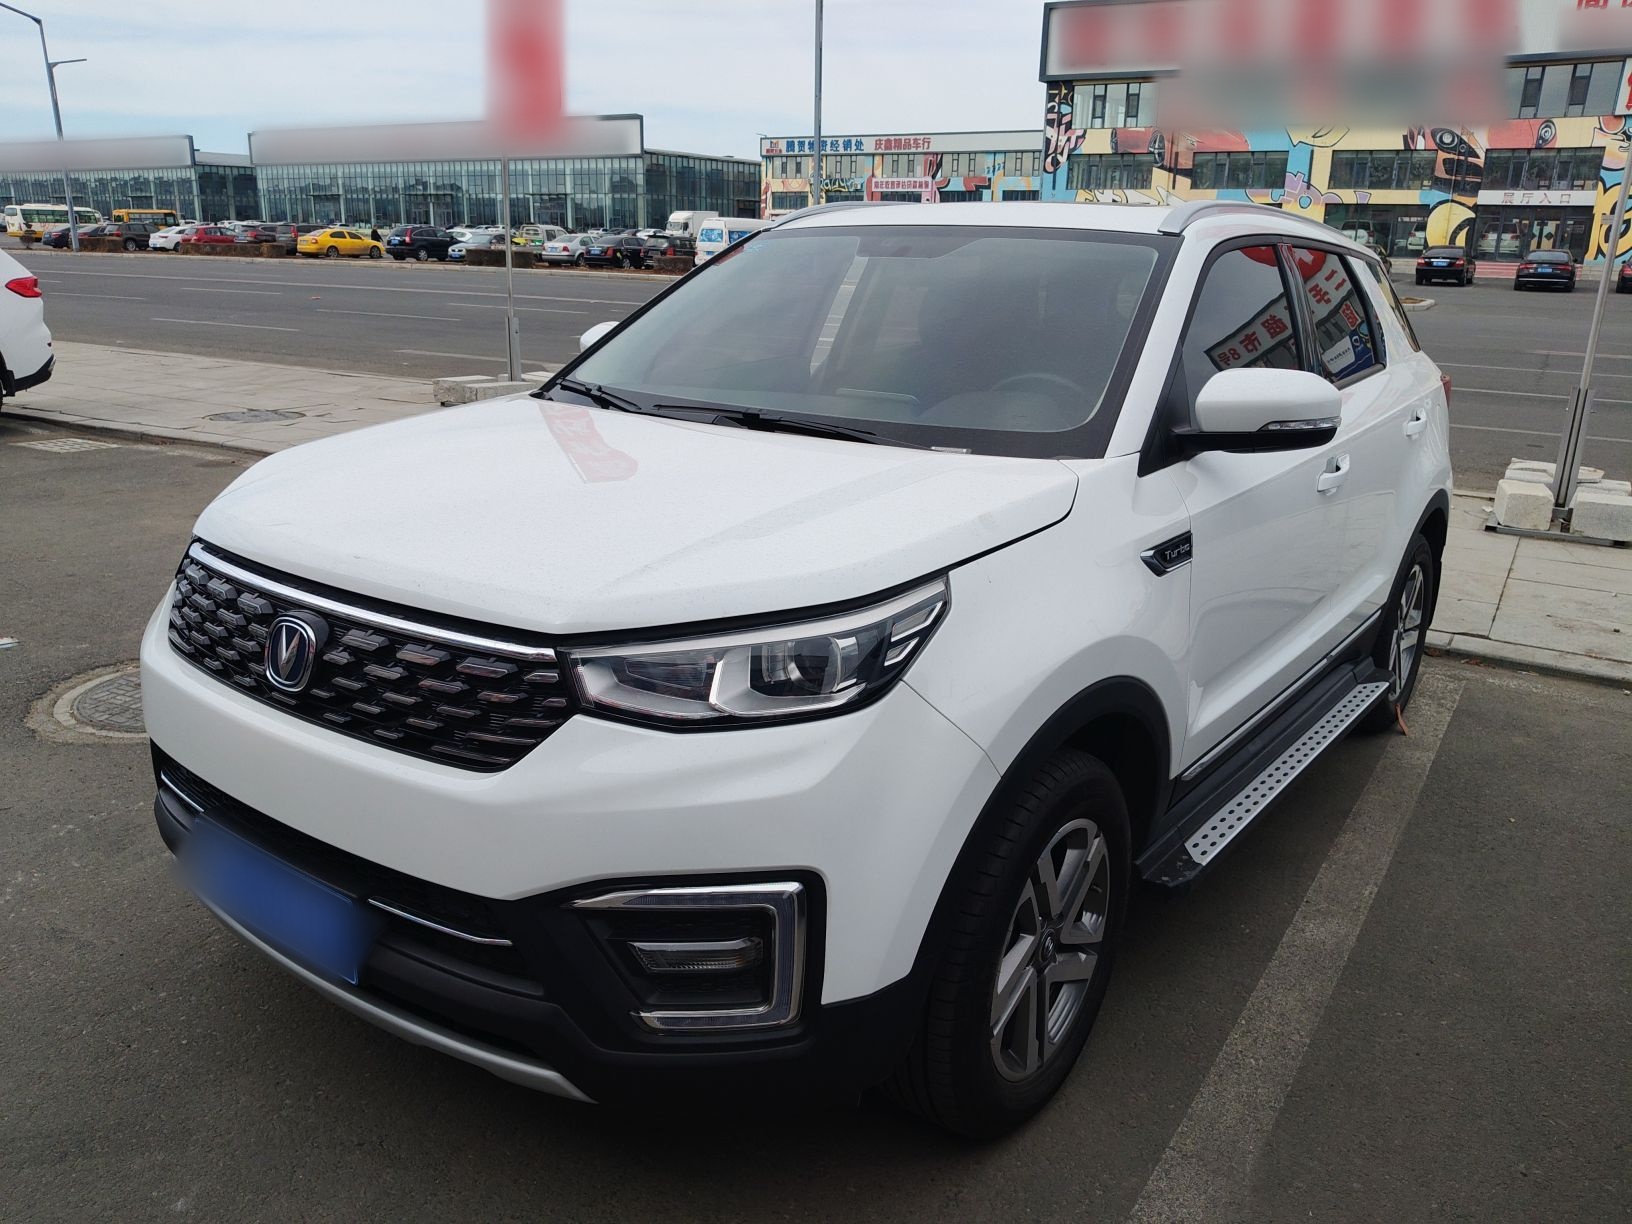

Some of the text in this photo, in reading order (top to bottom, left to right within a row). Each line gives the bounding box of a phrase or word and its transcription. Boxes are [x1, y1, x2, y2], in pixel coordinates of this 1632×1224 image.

[1501, 192, 1572, 204] 展厅入口
[1164, 543, 1190, 561] Turbo
